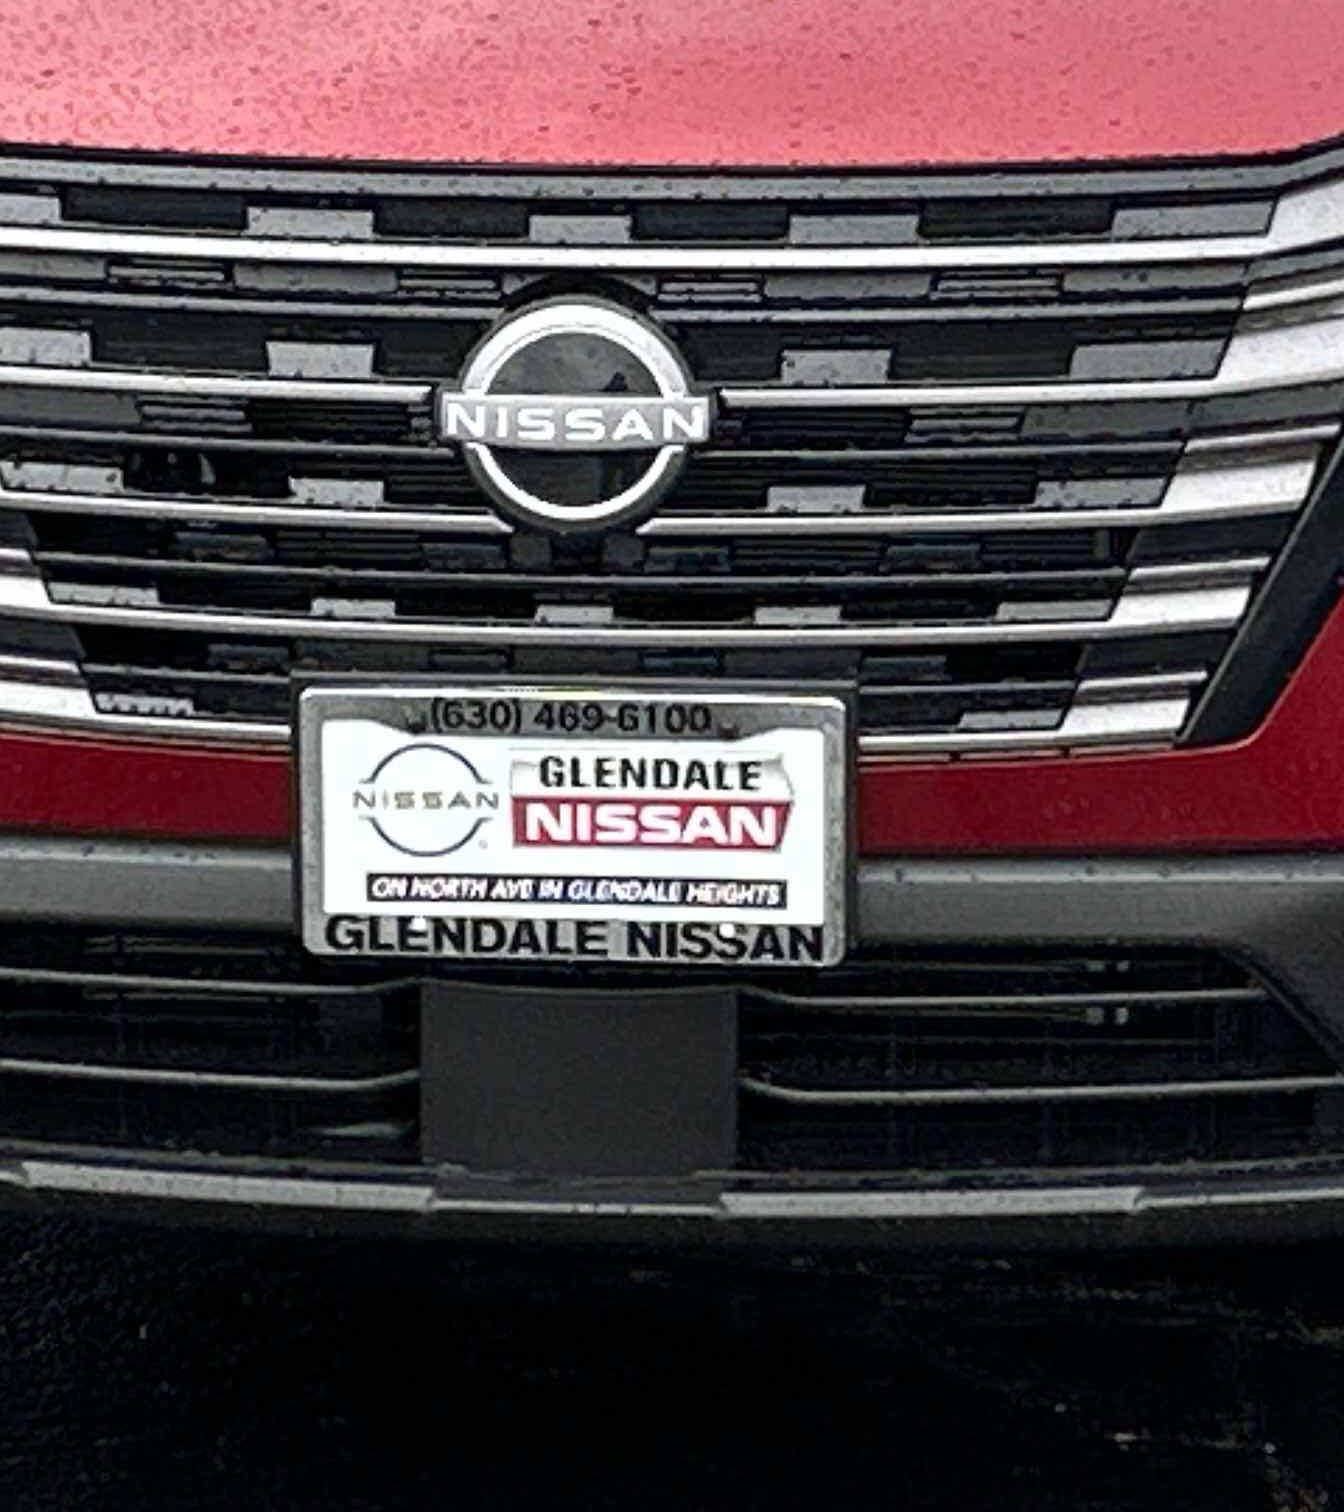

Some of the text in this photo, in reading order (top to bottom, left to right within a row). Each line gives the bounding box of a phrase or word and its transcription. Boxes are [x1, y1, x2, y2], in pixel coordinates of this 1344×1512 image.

[446, 405, 703, 440] NISSAN
[430, 697, 712, 734] (630) 469-6100
[538, 755, 762, 792] GLENDALE
[352, 790, 499, 810] NISSAN
[524, 802, 778, 847] NISSAN
[372, 876, 406, 898] ON
[410, 876, 488, 899] NORTH
[537, 879, 561, 900] IN
[567, 880, 682, 903] GLENDALE
[685, 882, 781, 906] HEIGHTS
[324, 915, 824, 962] GLENDALE NISSAN
